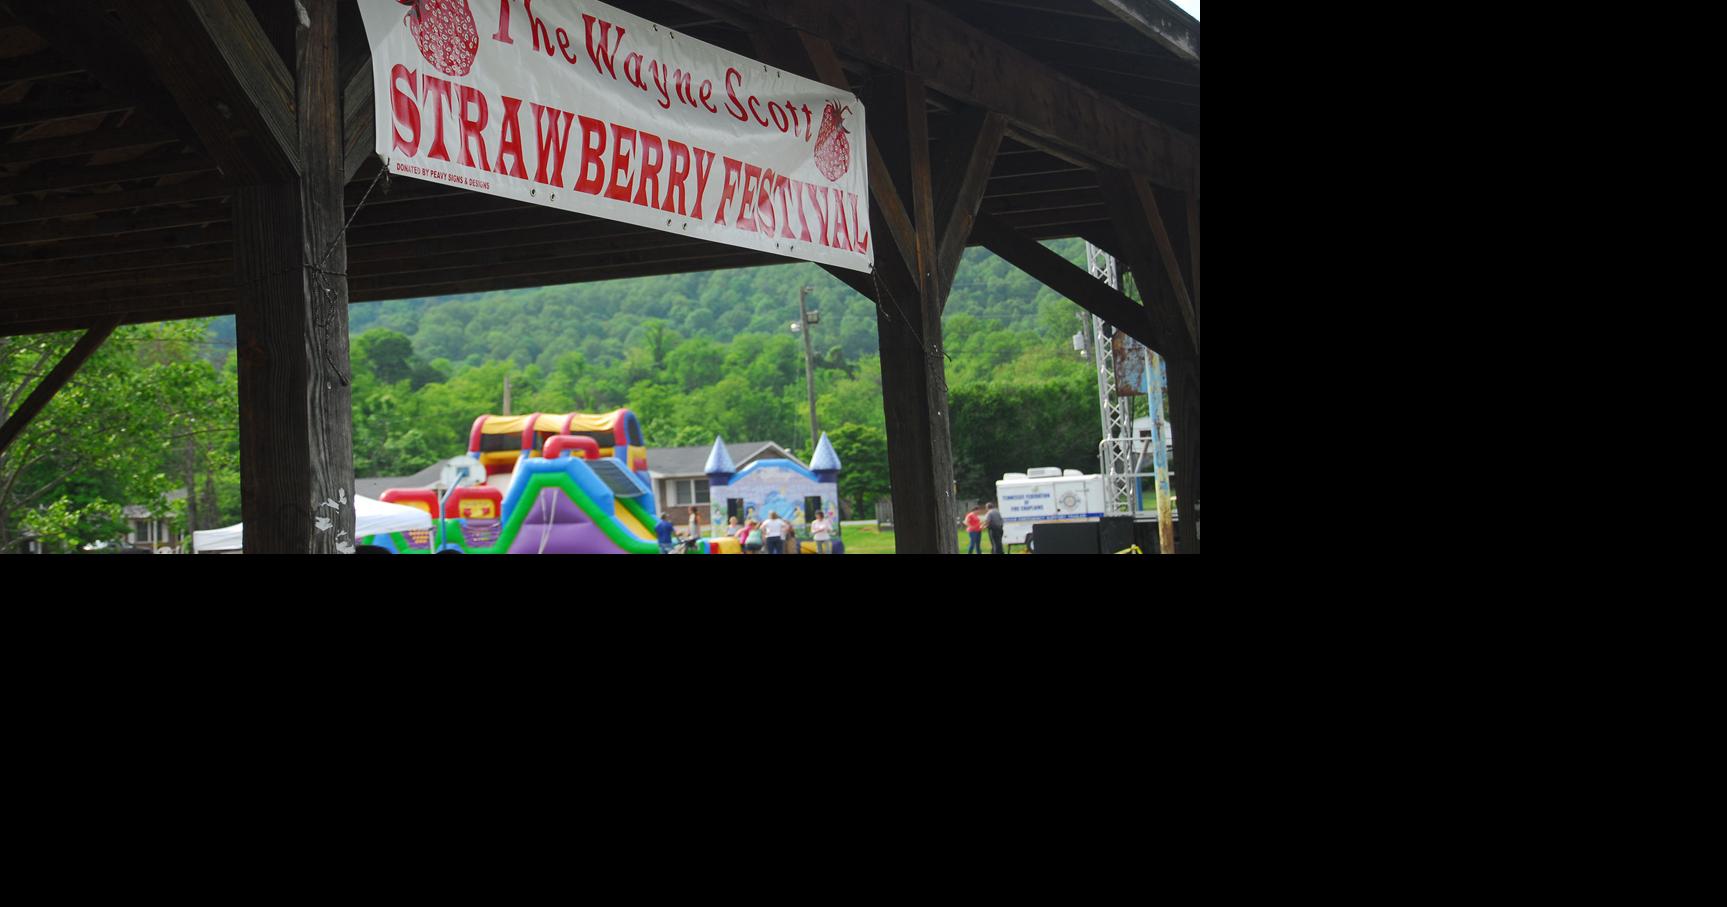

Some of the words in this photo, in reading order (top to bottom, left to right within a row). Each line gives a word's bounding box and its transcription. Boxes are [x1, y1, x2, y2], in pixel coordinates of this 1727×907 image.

[492, 0, 577, 64] The
[582, 13, 717, 113] Wayne
[724, 67, 812, 142] Scott
[390, 63, 716, 220] STRAWBERRY
[714, 157, 868, 254] FESTIVAL
[396, 163, 421, 175] DONATED
[421, 168, 431, 176] BY
[430, 169, 447, 180] PEAVY
[448, 173, 464, 184] SIGNS
[468, 178, 490, 190] DESIGNS
